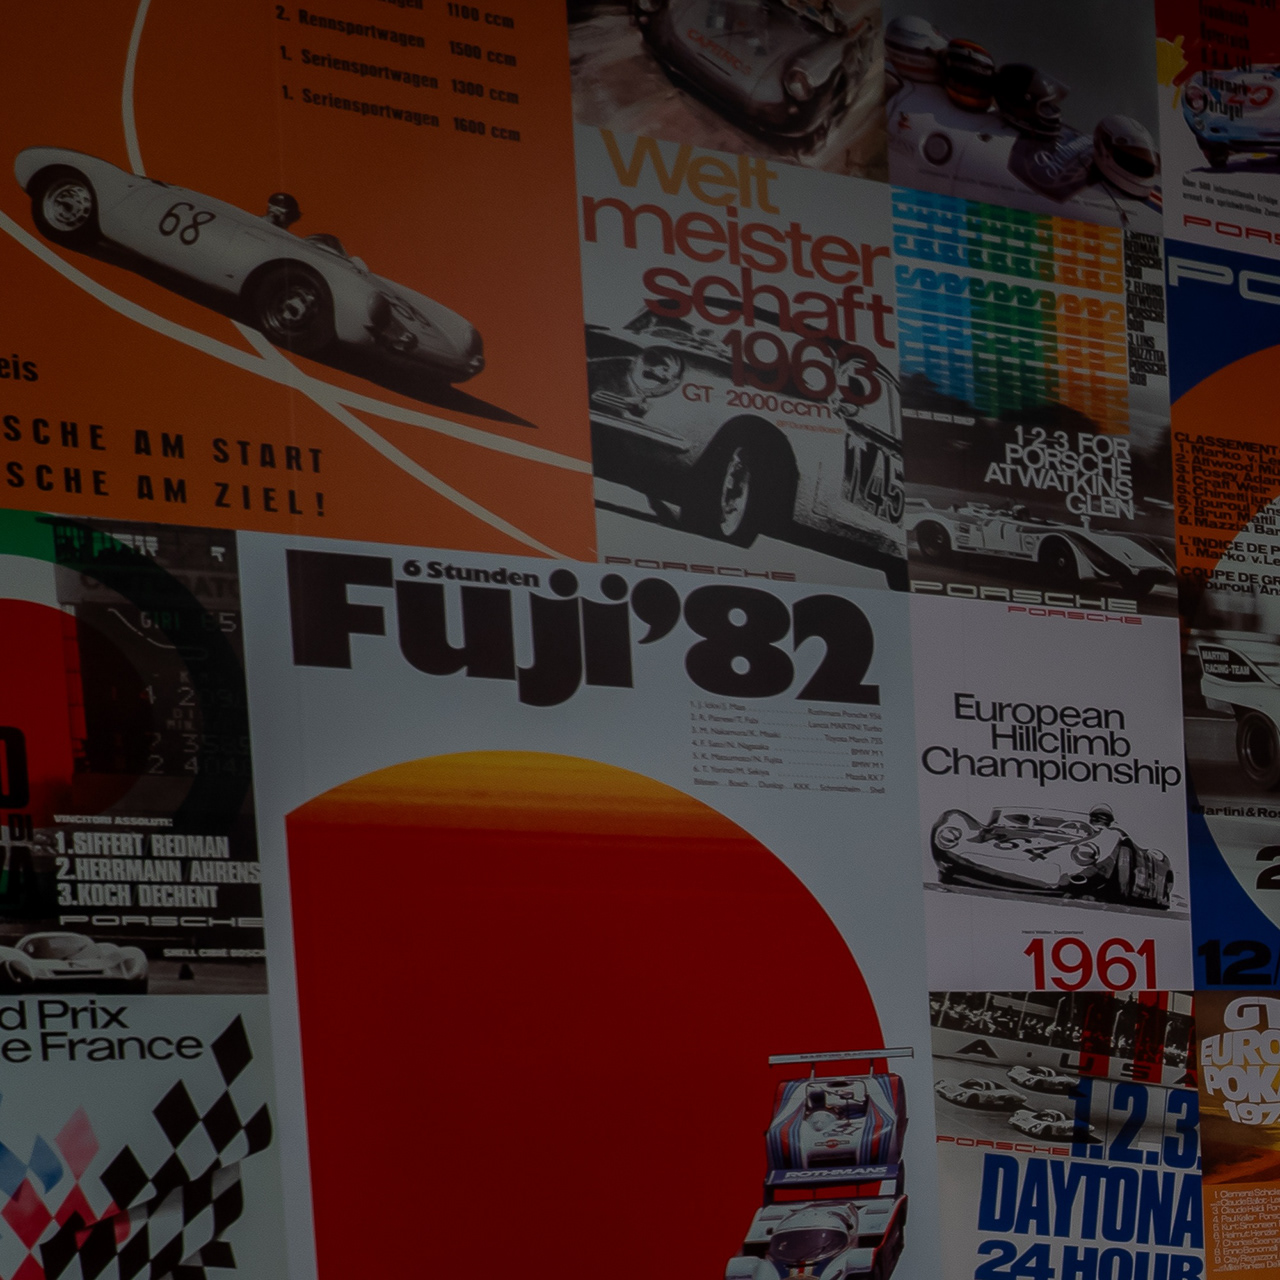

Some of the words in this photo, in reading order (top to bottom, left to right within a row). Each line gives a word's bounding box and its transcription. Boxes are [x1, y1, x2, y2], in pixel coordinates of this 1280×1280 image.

[302, 88, 439, 128] Seriensportwagen
[454, 117, 486, 135] 1600
[491, 126, 521, 142] ccm
[601, 129, 780, 215] Welt
[159, 201, 216, 245] 68
[582, 195, 891, 288] meister
[642, 266, 896, 350] schaft
[722, 328, 882, 407] 1963
[682, 382, 714, 404] GT
[726, 389, 779, 413] 2000
[780, 398, 832, 419] ccm
[135, 429, 185, 459] AM
[212, 437, 322, 473] START
[1014, 425, 1070, 451] 1-2-3
[1077, 432, 1131, 460] FOR
[1175, 431, 1278, 456] CLASSEMENT
[1005, 443, 1132, 480] PORSCHE
[137, 475, 187, 503] AM
[214, 482, 325, 517] ZIEL!
[1014, 466, 1134, 500] WATKINS
[1065, 492, 1135, 520] GLEN
[1247, 543, 1267, 554] DE
[403, 560, 421, 577] 6
[427, 563, 539, 587] Stunden
[605, 555, 796, 582] PORSCHE
[1180, 566, 1235, 582] COUPE
[1238, 573, 1258, 583] DE
[910, 580, 1138, 613] PORSCHE
[1007, 605, 1142, 625] PORSCHE
[954, 693, 1125, 731] European
[992, 724, 1131, 756] Hillclimb
[922, 745, 1181, 792] Championship
[58, 915, 264, 928] PORSCHE
[1024, 937, 1156, 991] 1961
[37, 999, 129, 1029] Prix
[41, 1031, 203, 1061] France
[936, 1135, 1071, 1156] PORSCHE
[785, 1166, 888, 1178] ROTHMANS
[978, 1153, 1204, 1248] DAYTONA
